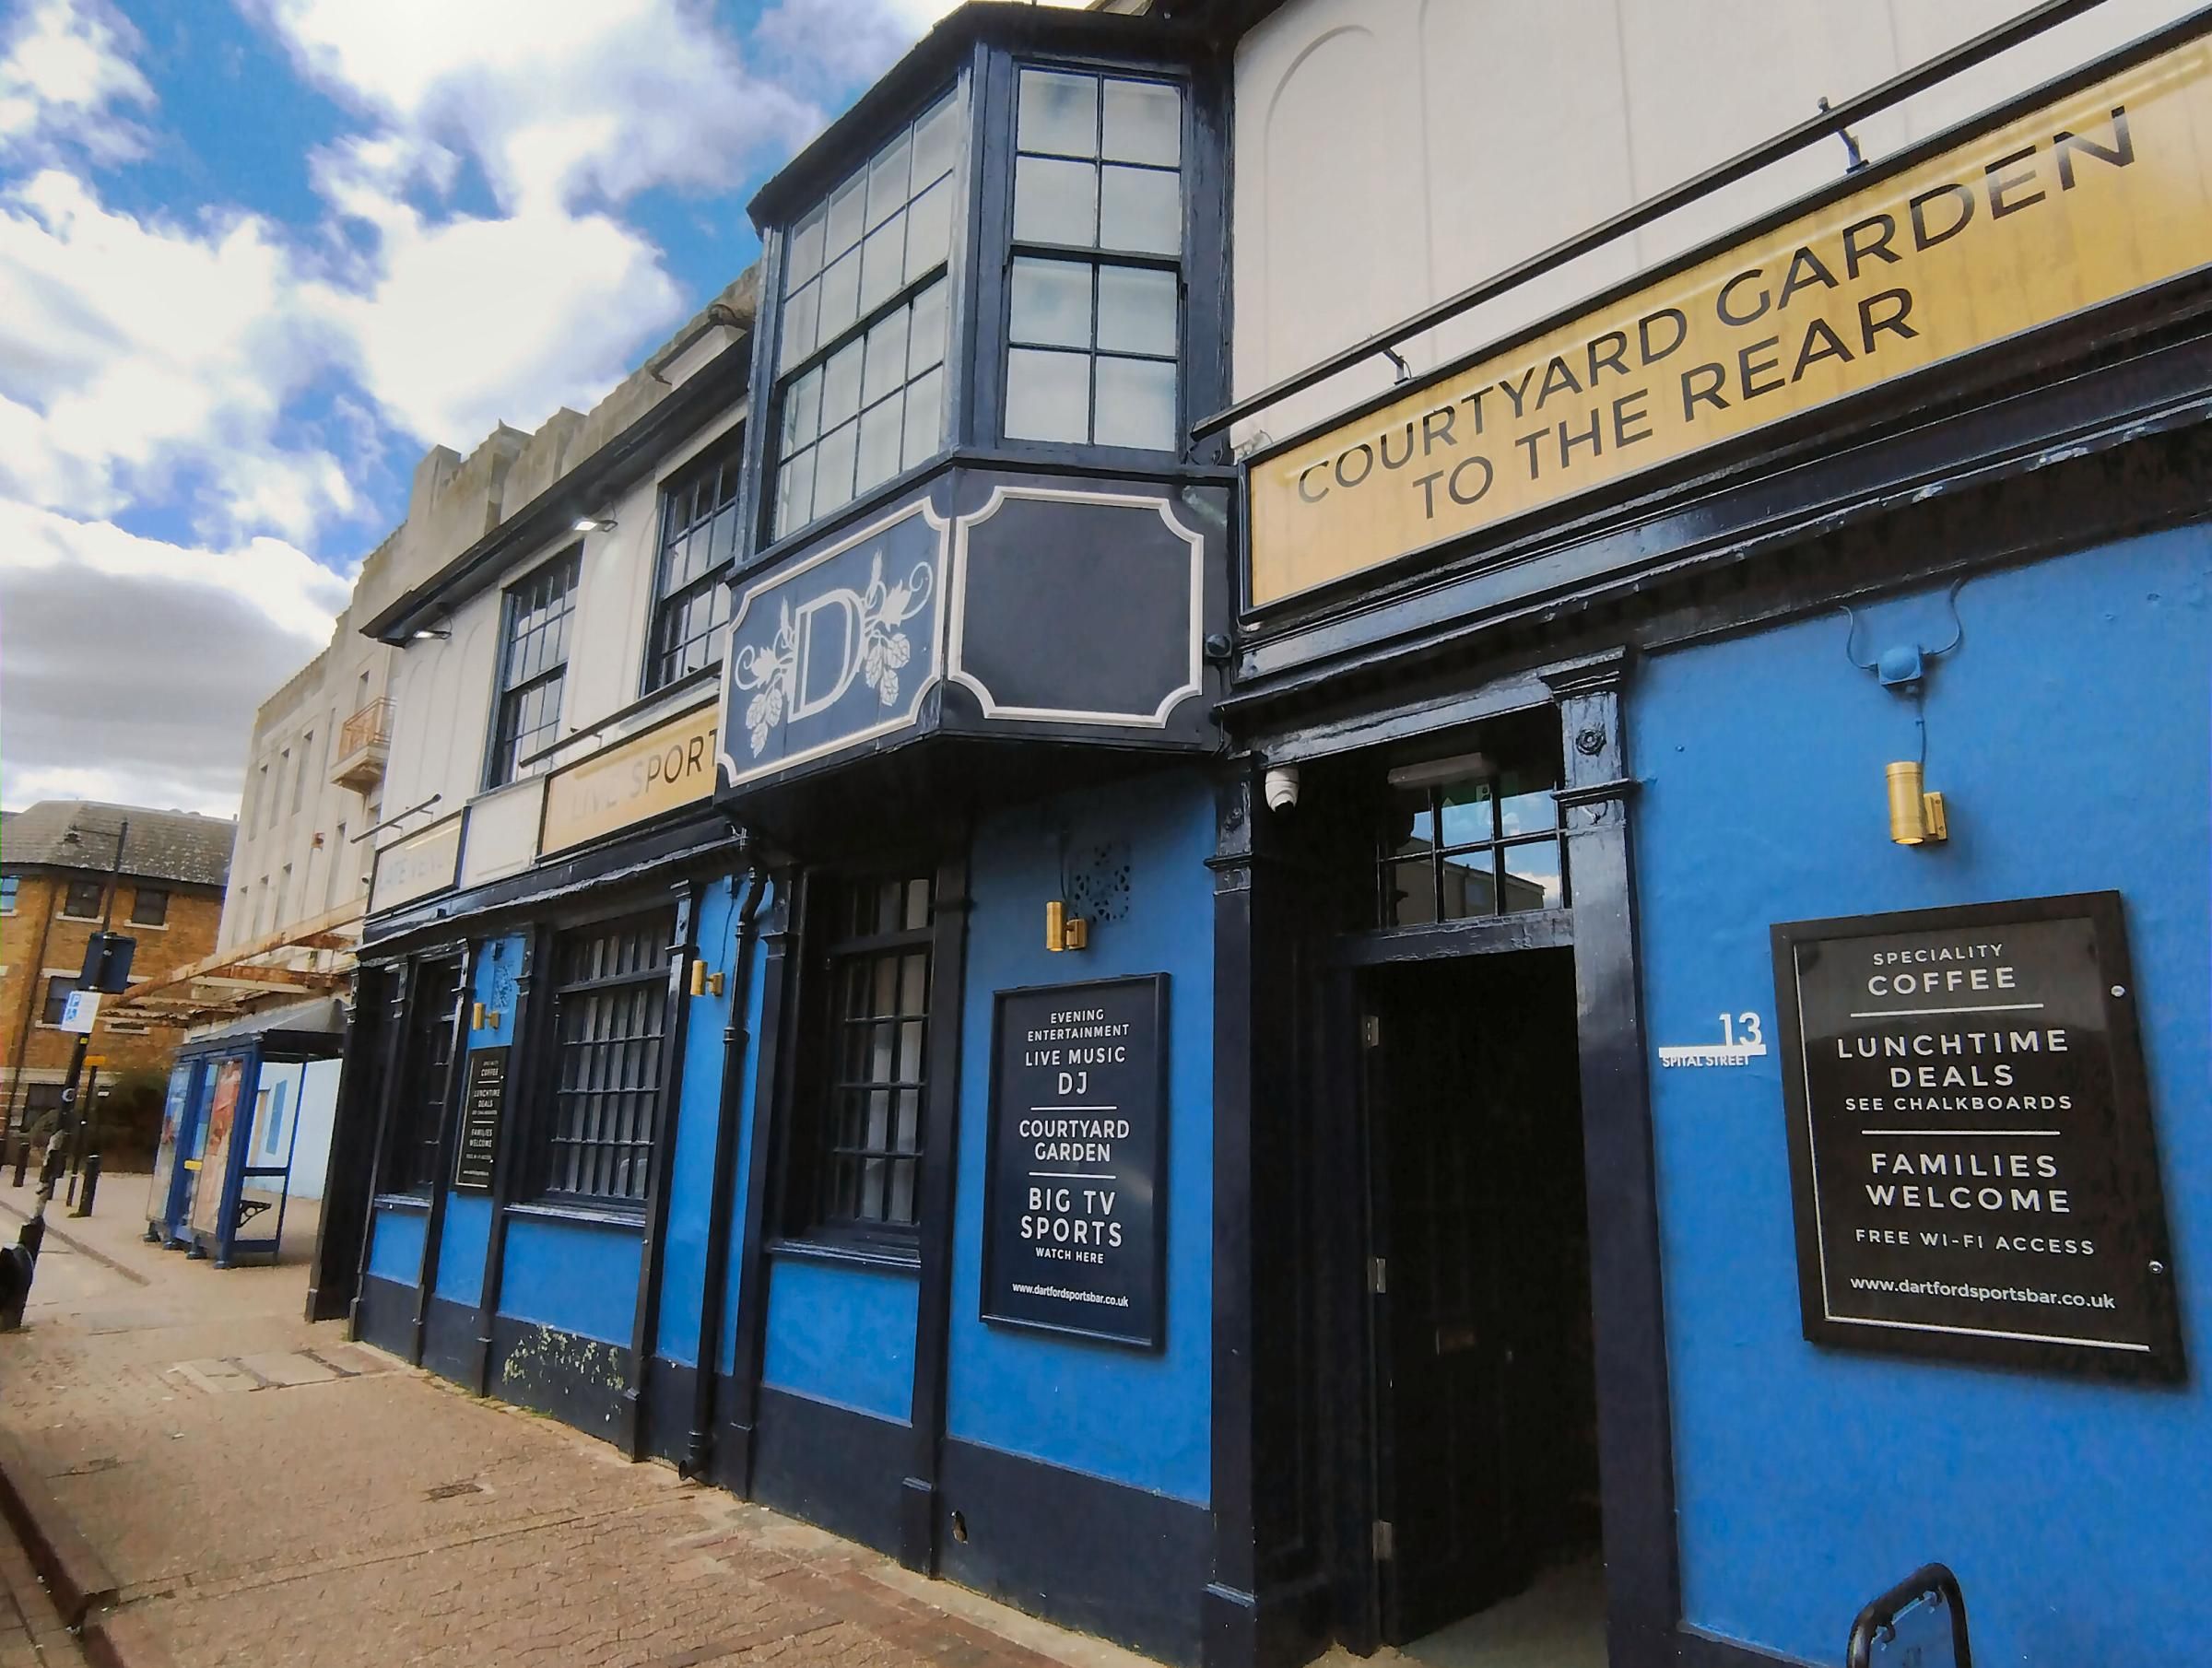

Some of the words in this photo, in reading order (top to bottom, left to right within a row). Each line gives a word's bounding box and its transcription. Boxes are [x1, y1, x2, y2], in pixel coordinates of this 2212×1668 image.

[1299, 308, 1688, 503] COURTYARD
[1716, 105, 2135, 326] GARDEN
[1412, 456, 1494, 519] TO
[1515, 388, 1653, 480] THE
[1680, 288, 1920, 423] REAR
[1874, 945, 2002, 965] SPECIALITY
[1868, 968, 2015, 995] COFFEE
[1051, 1009, 1103, 1023] EVENING
[1029, 1024, 1129, 1041] ENTERTAINMENT
[1719, 1012, 1762, 1047] 13
[1838, 1030, 2067, 1057] LUNCHTIME
[1026, 1051, 1060, 1065] LIVE
[1069, 1047, 1124, 1064] MUSIC
[1663, 1055, 1703, 1067] SPITAL
[1706, 1054, 1749, 1066] STREET
[1059, 1072, 1087, 1094] DJ
[1891, 1065, 2012, 1087] DEALS
[1846, 1098, 1883, 1110] SEE
[1895, 1097, 2071, 1110] CHALKBOARDS
[1019, 1121, 1129, 1138] COURTYARD
[1035, 1143, 1110, 1161] GARDEN
[1872, 1154, 2056, 1177] FAMILIES
[1030, 1188, 1069, 1212] BIG
[1084, 1191, 1115, 1215] TV
[1865, 1185, 2069, 1212] WELCOME
[1021, 1216, 1121, 1247] SPORTS
[1856, 1229, 1909, 1244] FREE
[1920, 1233, 1983, 1248] WI-FI
[1996, 1237, 2093, 1254] ACCESS
[1036, 1248, 1071, 1260] WATCH
[1077, 1251, 1103, 1263] HERE
[1013, 1284, 1128, 1307] www.dartfordsportsbar.co.uk
[1851, 1279, 2115, 1308] www.dartfordsportsbar.co.uk
